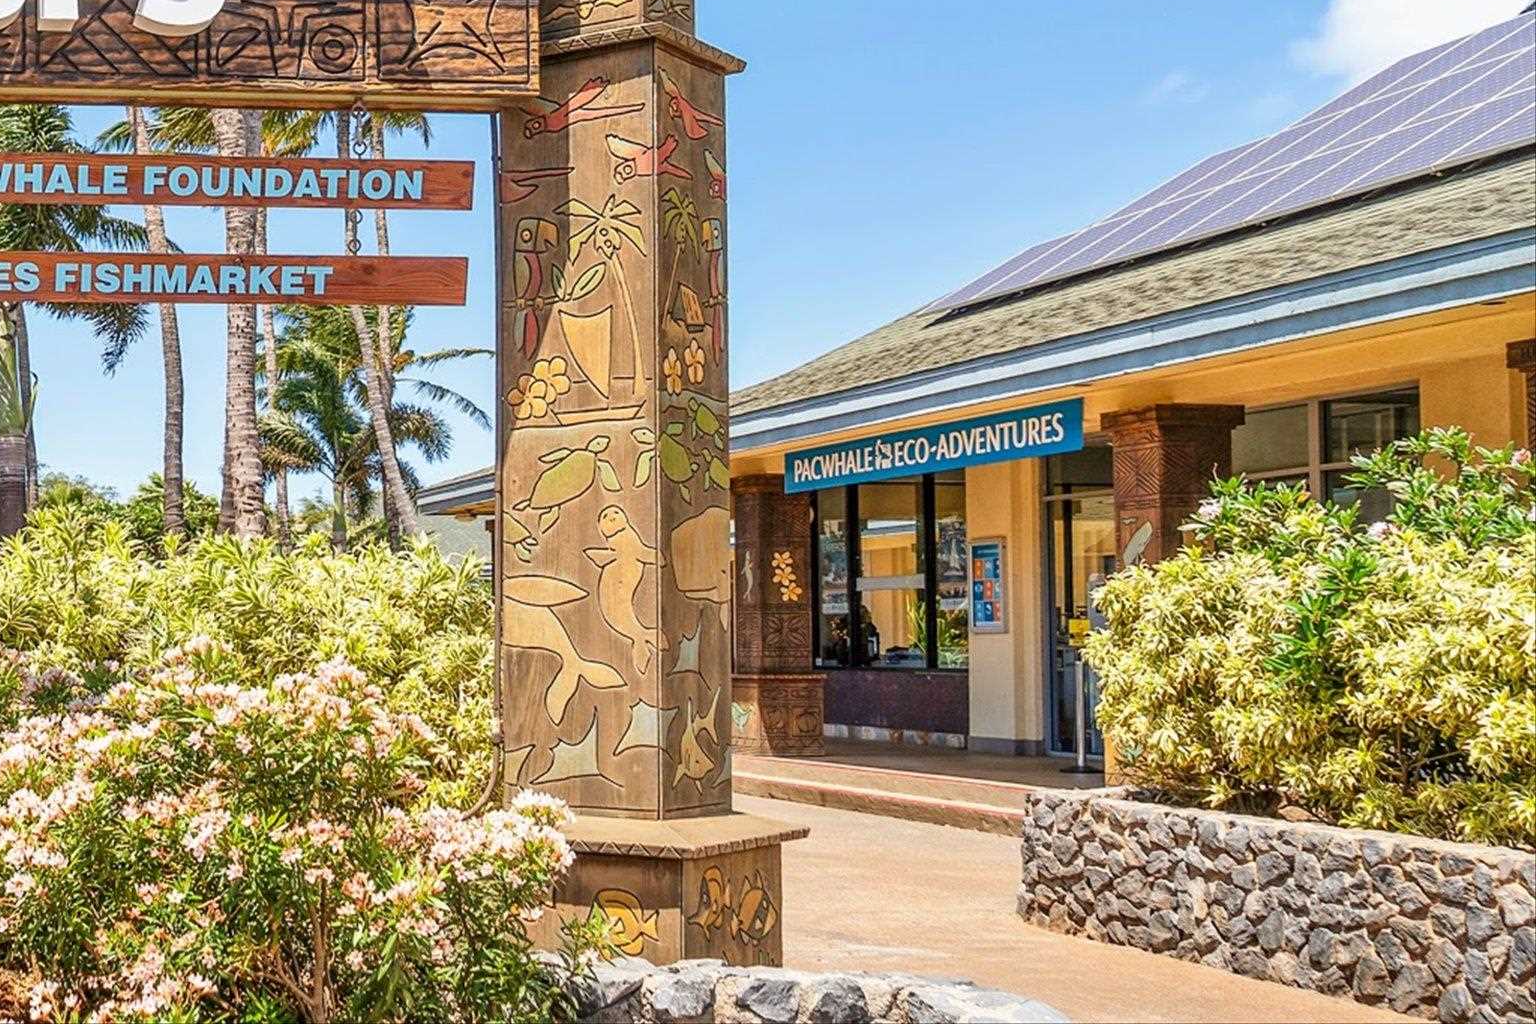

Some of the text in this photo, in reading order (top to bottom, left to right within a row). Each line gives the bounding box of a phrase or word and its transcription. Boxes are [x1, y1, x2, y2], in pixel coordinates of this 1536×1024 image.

[144, 166, 423, 200] FOUNDATION
[55, 263, 333, 296] FISHMARKET
[793, 413, 1064, 483] PACWHALE ECO-ADVENTURES
